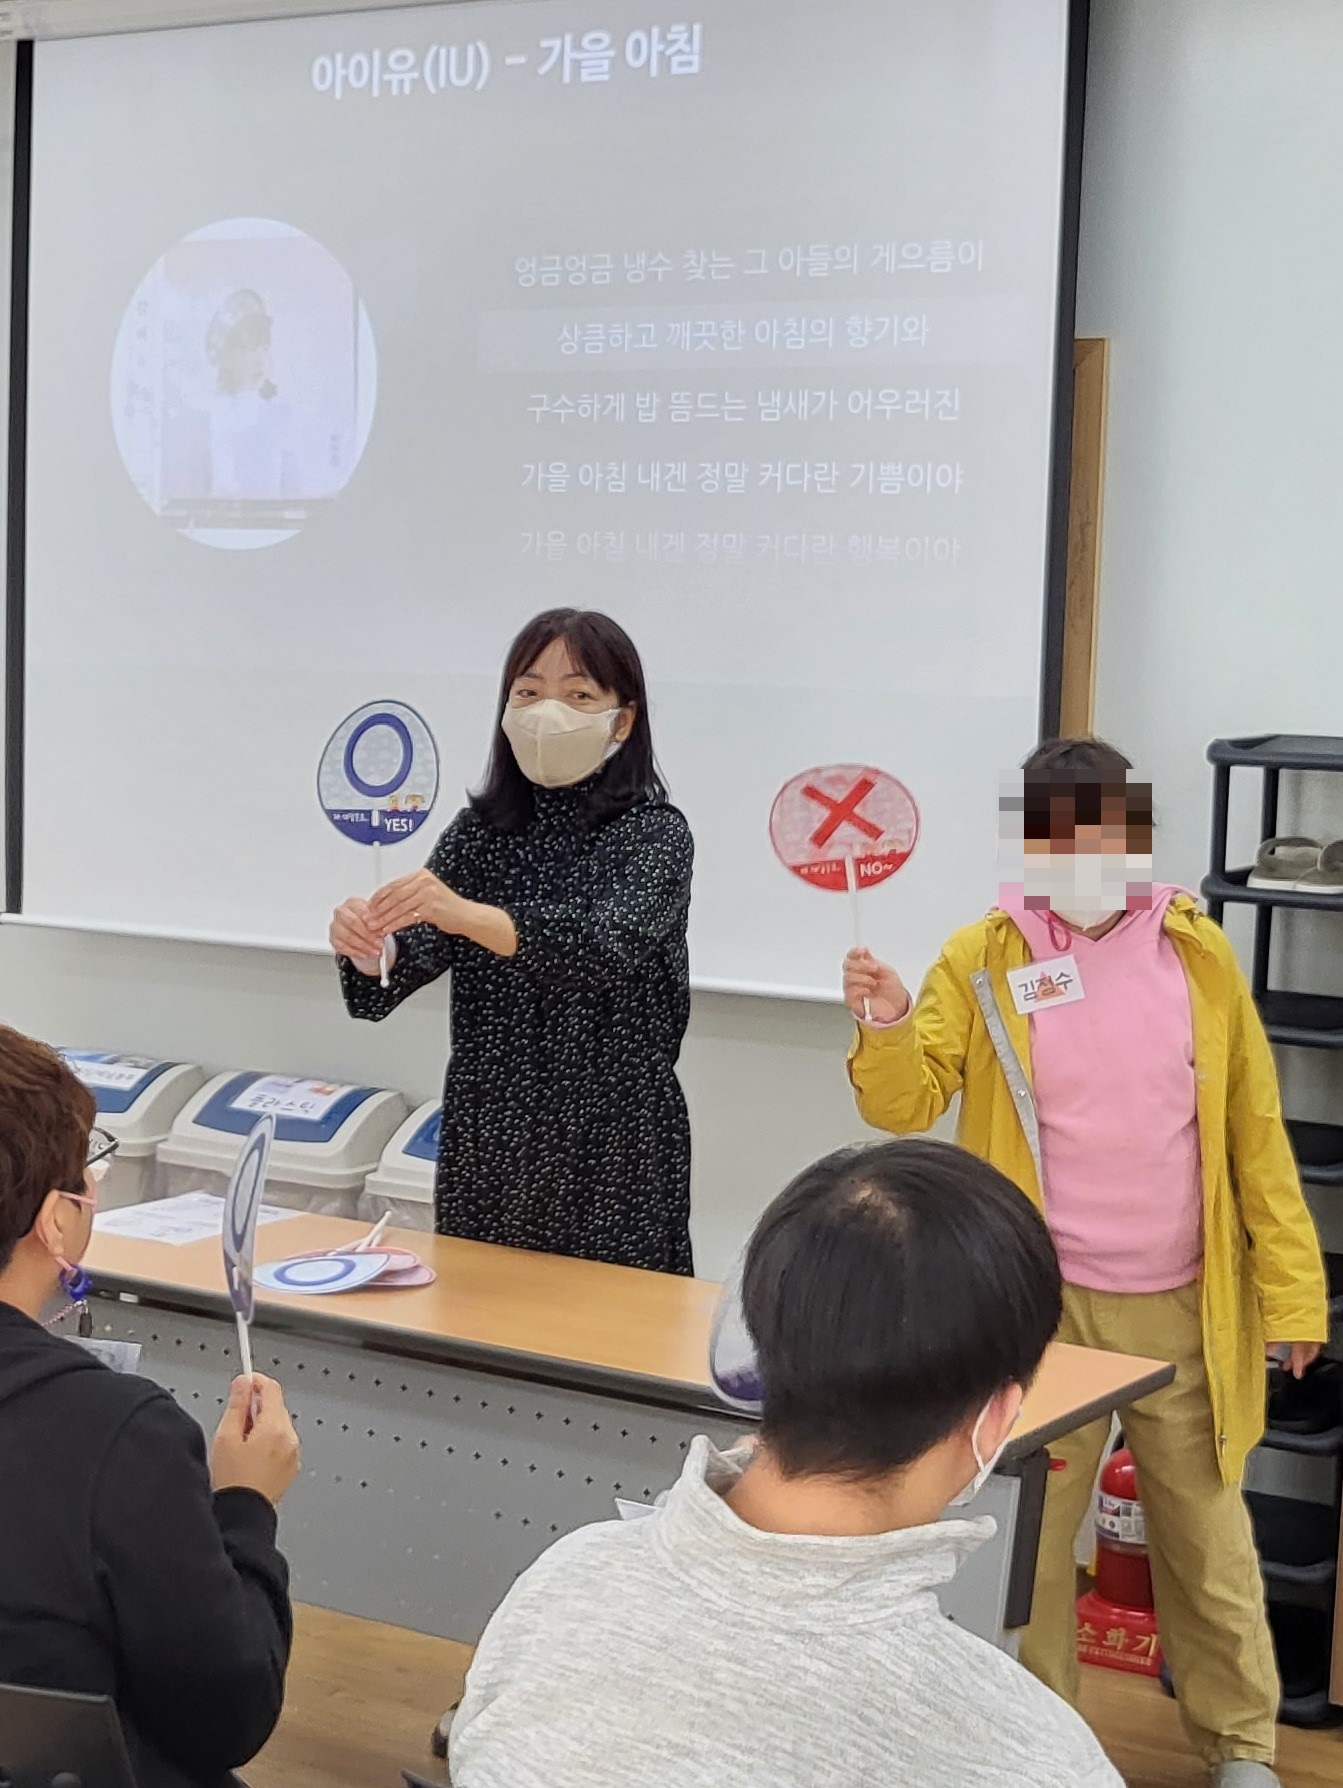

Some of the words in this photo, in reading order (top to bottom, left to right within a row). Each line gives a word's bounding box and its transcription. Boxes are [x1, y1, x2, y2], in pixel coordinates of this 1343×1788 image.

[312, 40, 491, 99] 아이유(IU)
[537, 31, 616, 84] 가을
[625, 22, 704, 77] 아침
[514, 253, 614, 288] 엉금엉금
[624, 250, 673, 284] 냉수
[682, 248, 736, 282] 찾는
[743, 249, 769, 275] 그
[778, 243, 859, 277] 아들의
[870, 239, 985, 274] 게으름이
[557, 322, 658, 355] 상큼하고
[666, 319, 745, 352] 깨끗한
[754, 316, 834, 351] 아침의
[845, 312, 931, 348] 향기와
[526, 391, 626, 425] 구수하게
[635, 391, 658, 423] 밥
[668, 390, 747, 423] 뜸드는
[757, 388, 837, 422] 냄새가
[847, 387, 961, 422] 어우러진
[520, 460, 571, 494] 가을
[578, 461, 627, 494] 아침
[637, 460, 687, 494] 내겐
[696, 460, 748, 495] 정말
[758, 460, 840, 495] 커다란
[849, 460, 964, 496] 기쁨이야
[520, 528, 568, 562] 가을
[576, 529, 625, 563] 아침
[635, 530, 686, 563] 내겐
[696, 530, 746, 564] 정말
[757, 531, 837, 566] 커다란
[847, 532, 963, 570] 행복이야
[384, 818, 414, 833] YES!
